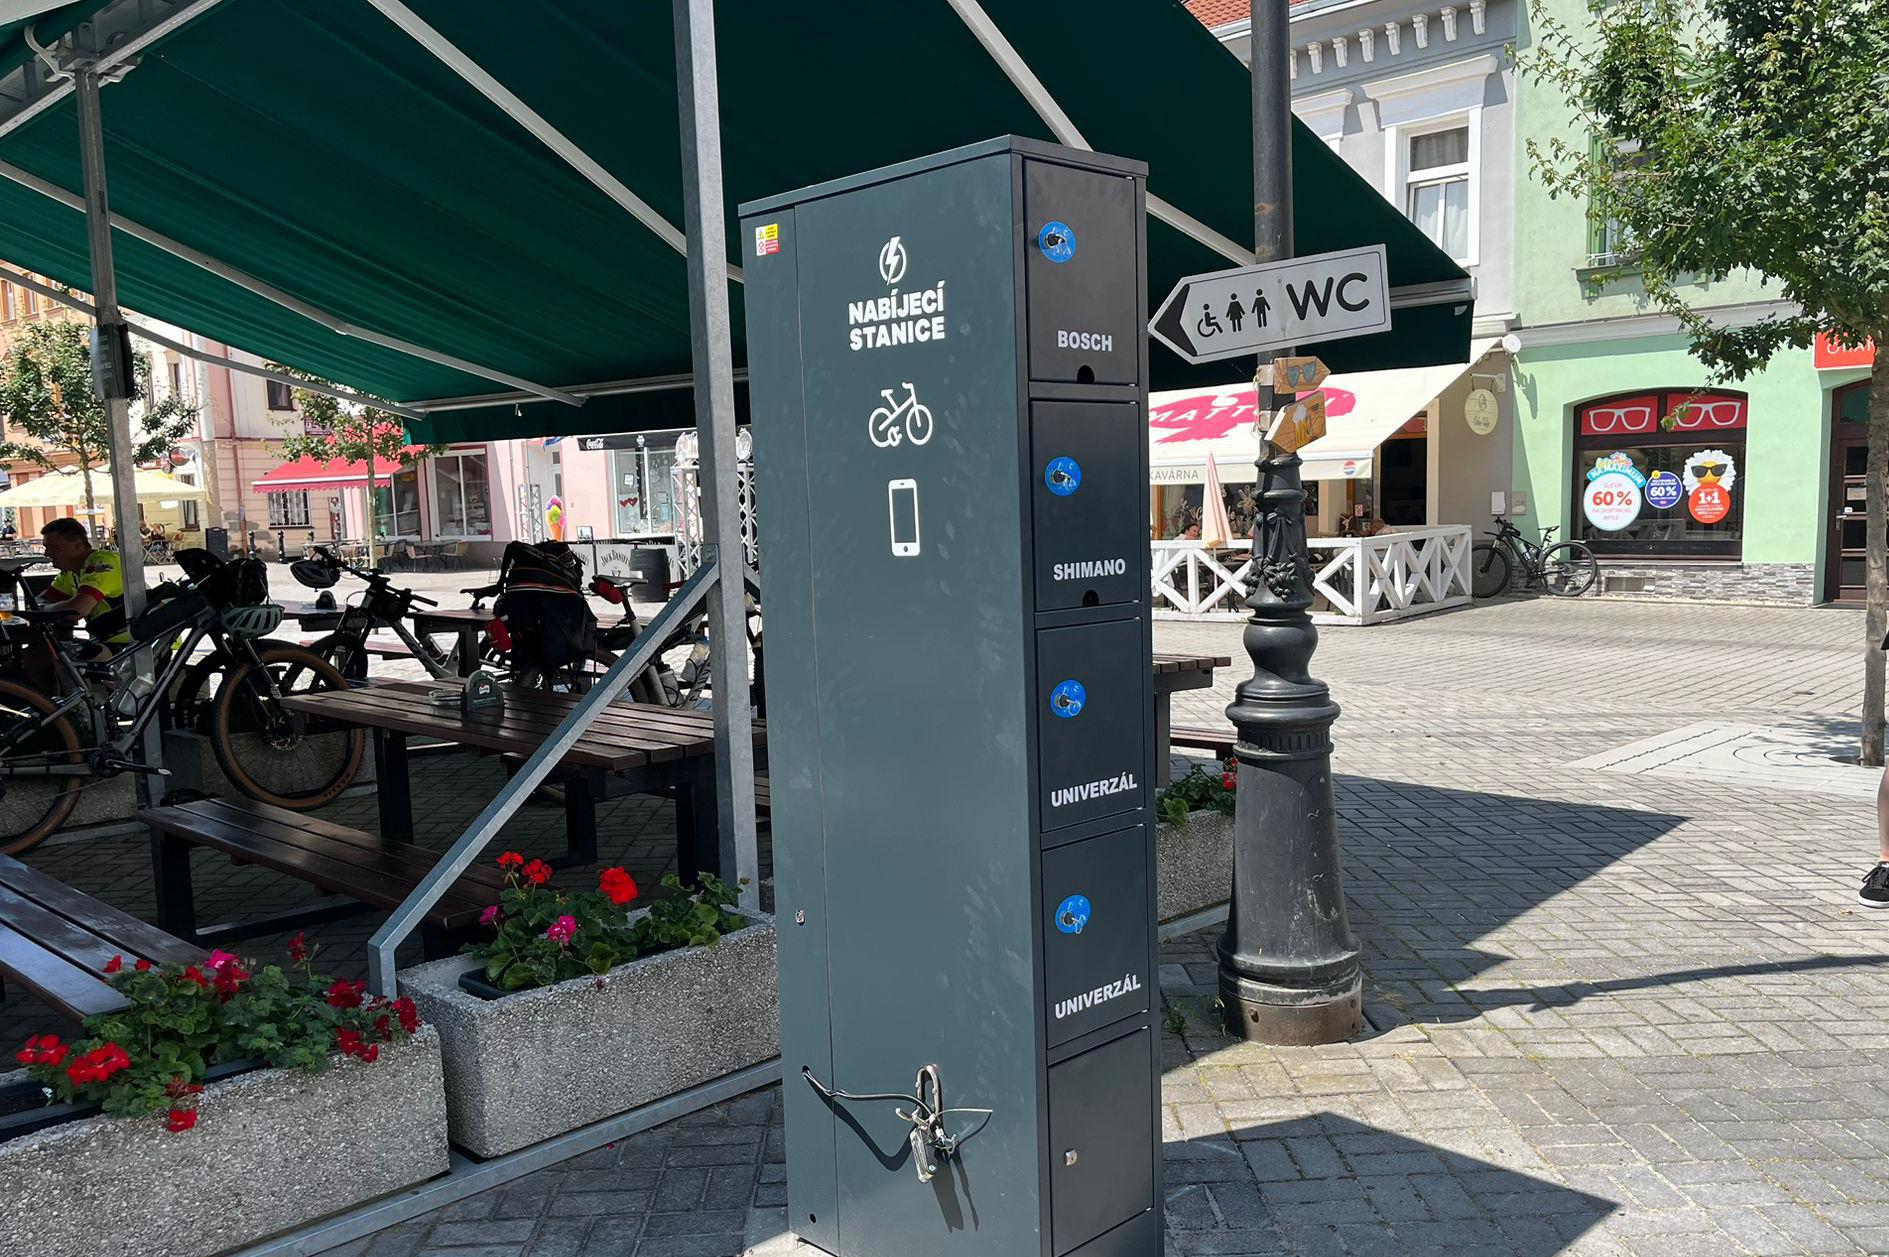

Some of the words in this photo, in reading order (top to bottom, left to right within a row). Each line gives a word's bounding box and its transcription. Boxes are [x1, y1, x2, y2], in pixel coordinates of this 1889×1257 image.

[848, 280, 945, 325] NABÍJECÍ
[1285, 272, 1370, 321] WC
[850, 316, 945, 351] STANICE
[1057, 330, 1113, 352] BOSCH
[1698, 491, 1721, 504] 1+1
[1053, 558, 1126, 581] SHIMANO
[1051, 771, 1138, 807] UNIVERZÁL
[1055, 973, 1141, 1019] UNIVERZÁL
